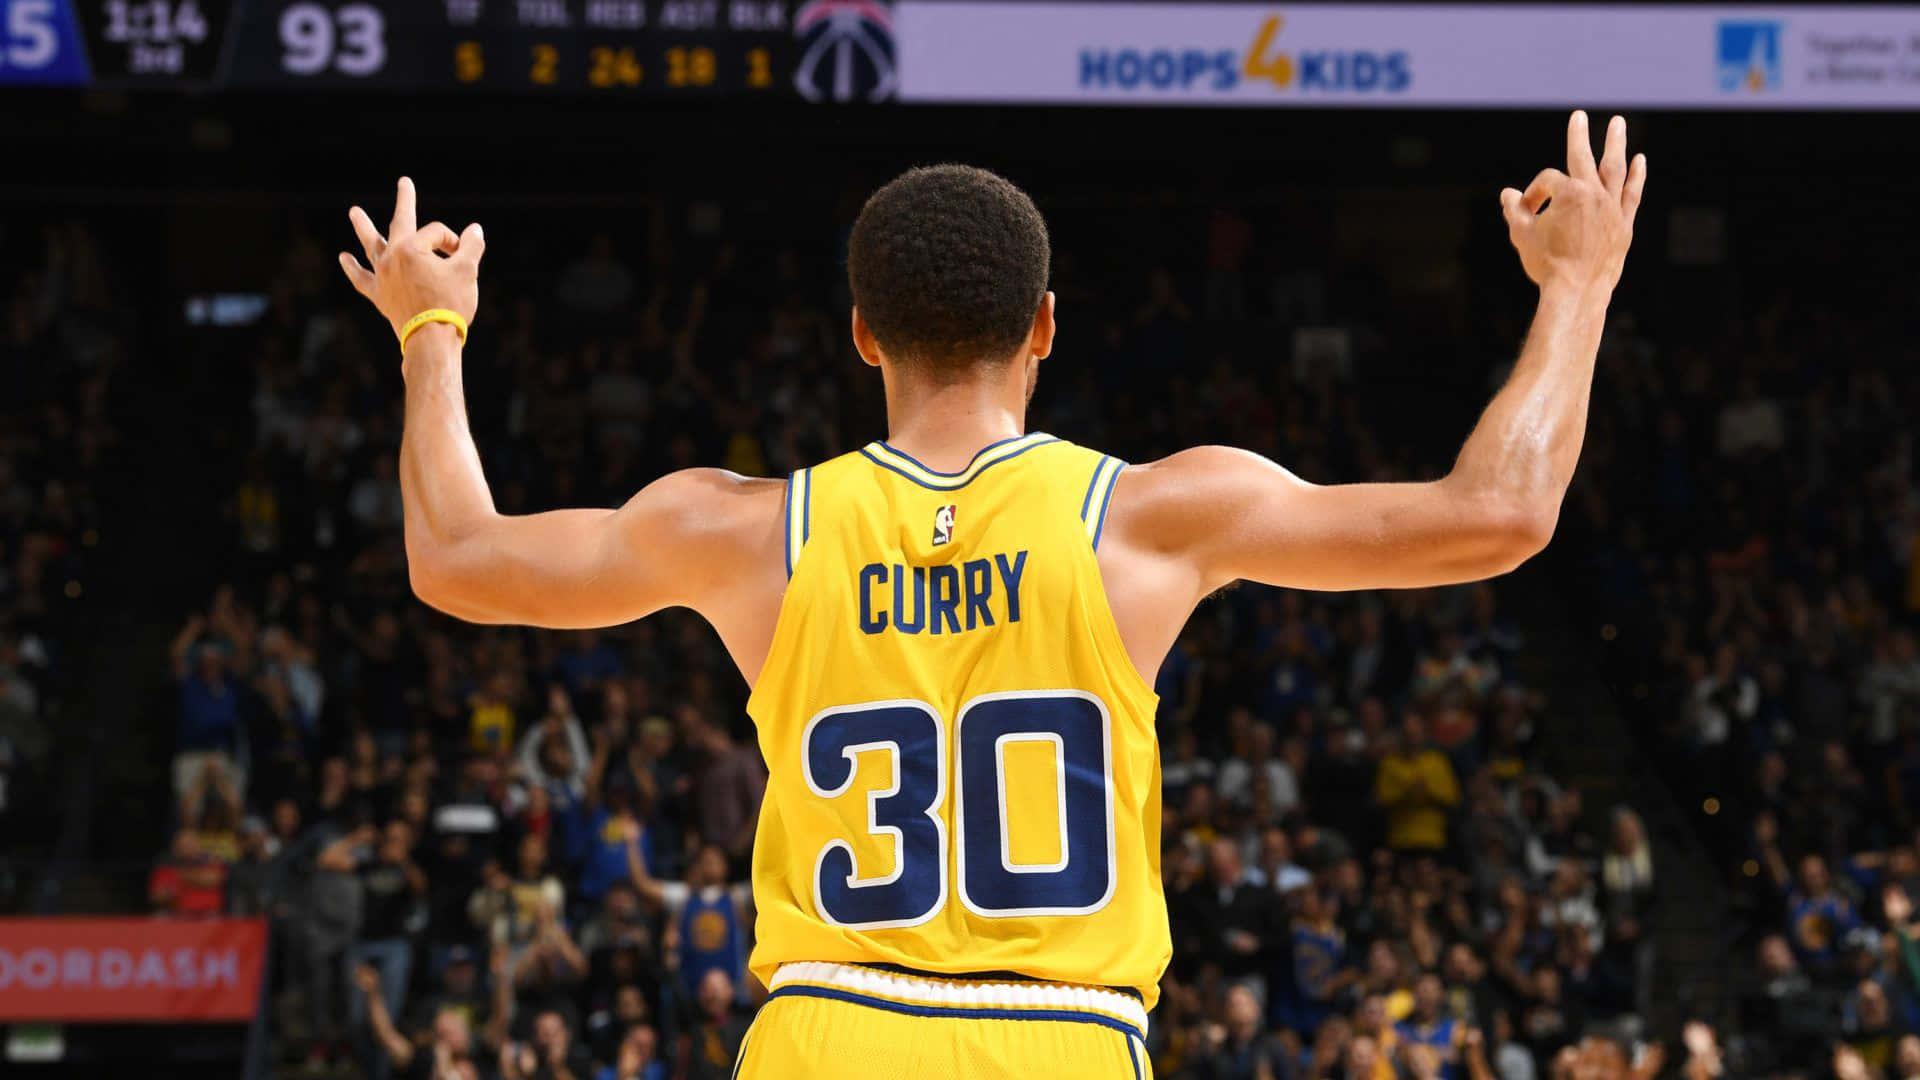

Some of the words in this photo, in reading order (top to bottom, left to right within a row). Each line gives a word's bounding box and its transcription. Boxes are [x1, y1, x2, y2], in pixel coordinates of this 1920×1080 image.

[0, 0, 59, 68] 5
[103, 0, 207, 42] 1:14
[280, 4, 386, 75] 93
[530, 44, 558, 84] 2
[588, 46, 643, 87] 24
[746, 48, 773, 88] 1
[859, 550, 1028, 635] CURRY
[801, 690, 1116, 931] 30
